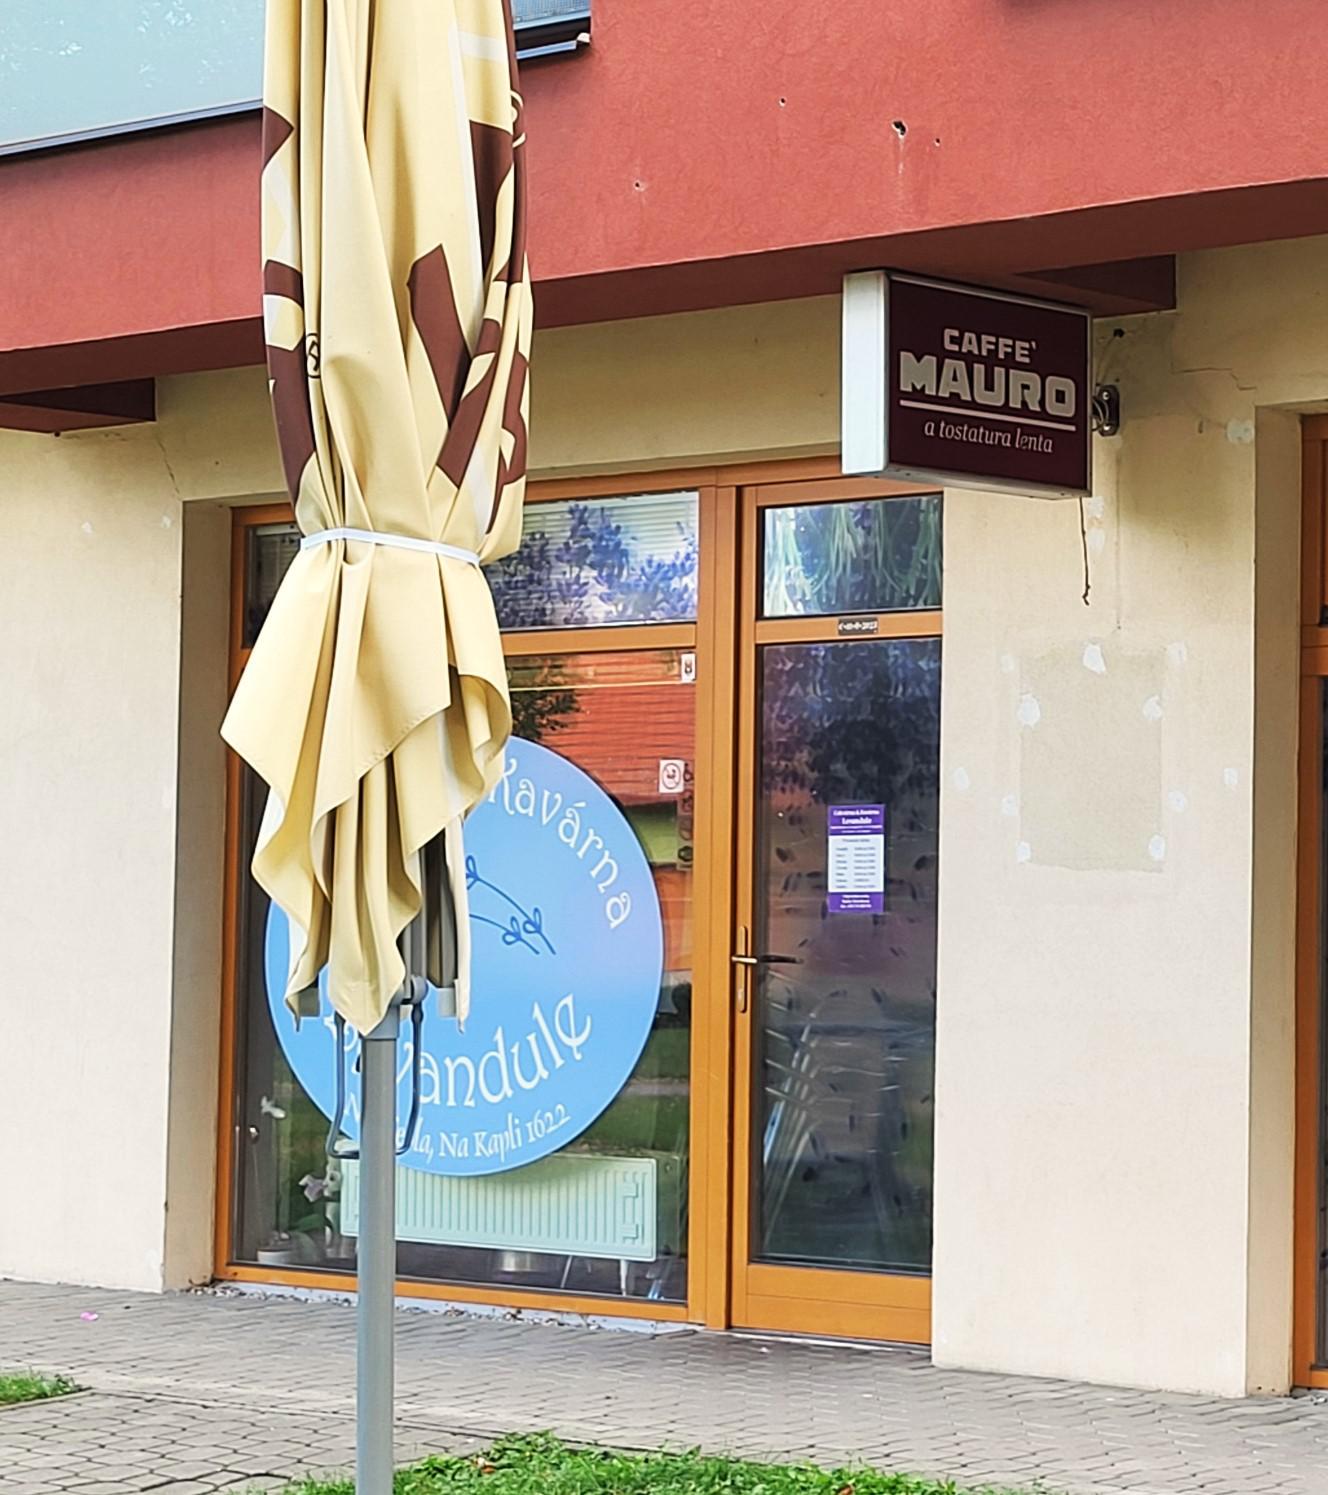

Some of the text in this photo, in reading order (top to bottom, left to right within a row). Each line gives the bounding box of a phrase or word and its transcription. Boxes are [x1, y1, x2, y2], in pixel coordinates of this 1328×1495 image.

[899, 351, 1076, 417] MAURO
[924, 420, 1053, 453] a tostatura lenta
[487, 757, 632, 930] Kavárna
[439, 1131, 469, 1158] Na
[474, 1112, 523, 1162] Kapli
[525, 1103, 571, 1143] 1622
